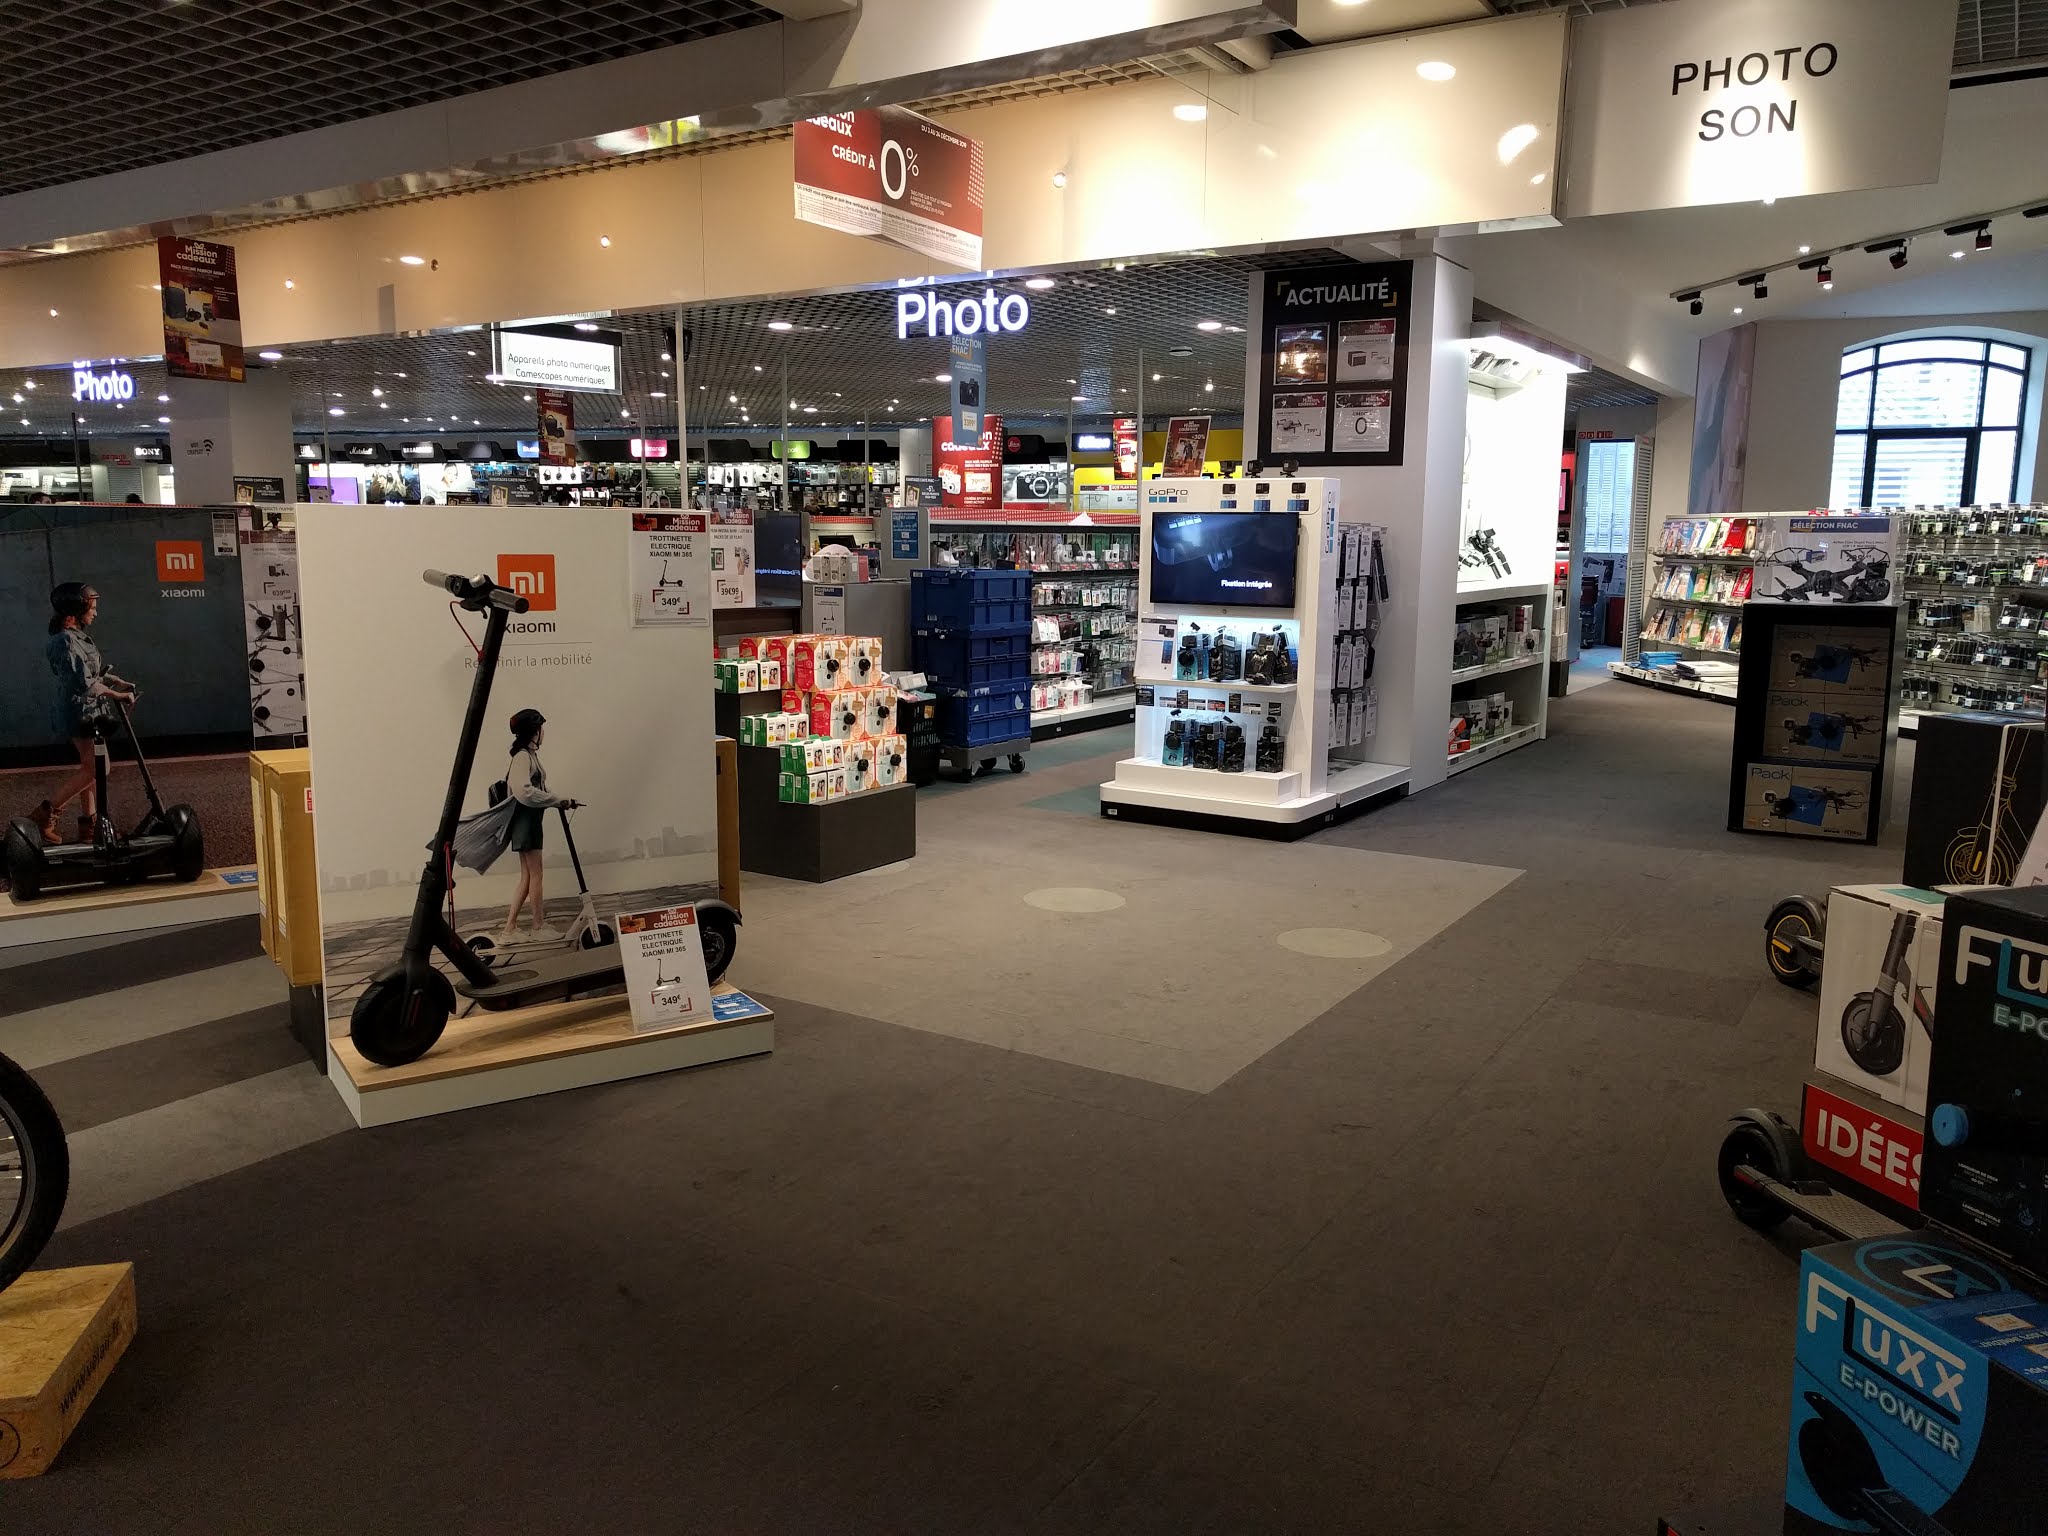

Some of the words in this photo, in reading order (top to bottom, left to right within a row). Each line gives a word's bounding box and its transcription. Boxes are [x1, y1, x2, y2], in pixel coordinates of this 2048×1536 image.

[1672, 43, 1838, 96] PHOTO
[1698, 100, 1797, 141] SON
[832, 145, 866, 167] CRÉDIT
[868, 154, 876, 171] À
[185, 244, 218, 259] Mission
[176, 252, 217, 265] cadeaux
[1285, 278, 1389, 306] ACTUALITÉ
[898, 288, 1029, 339] Photo
[951, 336, 982, 349] SÉLECTION
[952, 344, 968, 355] FNAC
[508, 353, 545, 366] Appareils
[547, 359, 569, 369] photo
[570, 362, 611, 373] numériques
[516, 369, 562, 381] Camescopes
[564, 375, 605, 385] numériques
[74, 370, 133, 401] Photo
[135, 447, 160, 456] SONY
[730, 511, 749, 519] Mission
[665, 523, 699, 531] cadeaux
[672, 517, 700, 526] Mission
[1792, 521, 1835, 529] SÉLECTION
[161, 589, 205, 598] xiaomi
[661, 597, 681, 606] 349€
[504, 622, 556, 633] xiaomi
[465, 656, 522, 668] Refinir
[526, 656, 537, 666] la
[541, 653, 592, 666] mobilité
[1770, 695, 1808, 707] Pack
[1751, 767, 1790, 781] Pack
[660, 912, 689, 922] Mission
[653, 919, 689, 929] cadeaux
[639, 930, 684, 942] TROTTINETTE
[641, 938, 684, 949] ELECTRIQUE
[641, 949, 666, 958] XIAOMI
[661, 995, 682, 1006] 349€
[1840, 1360, 1962, 1461] E-POWER
